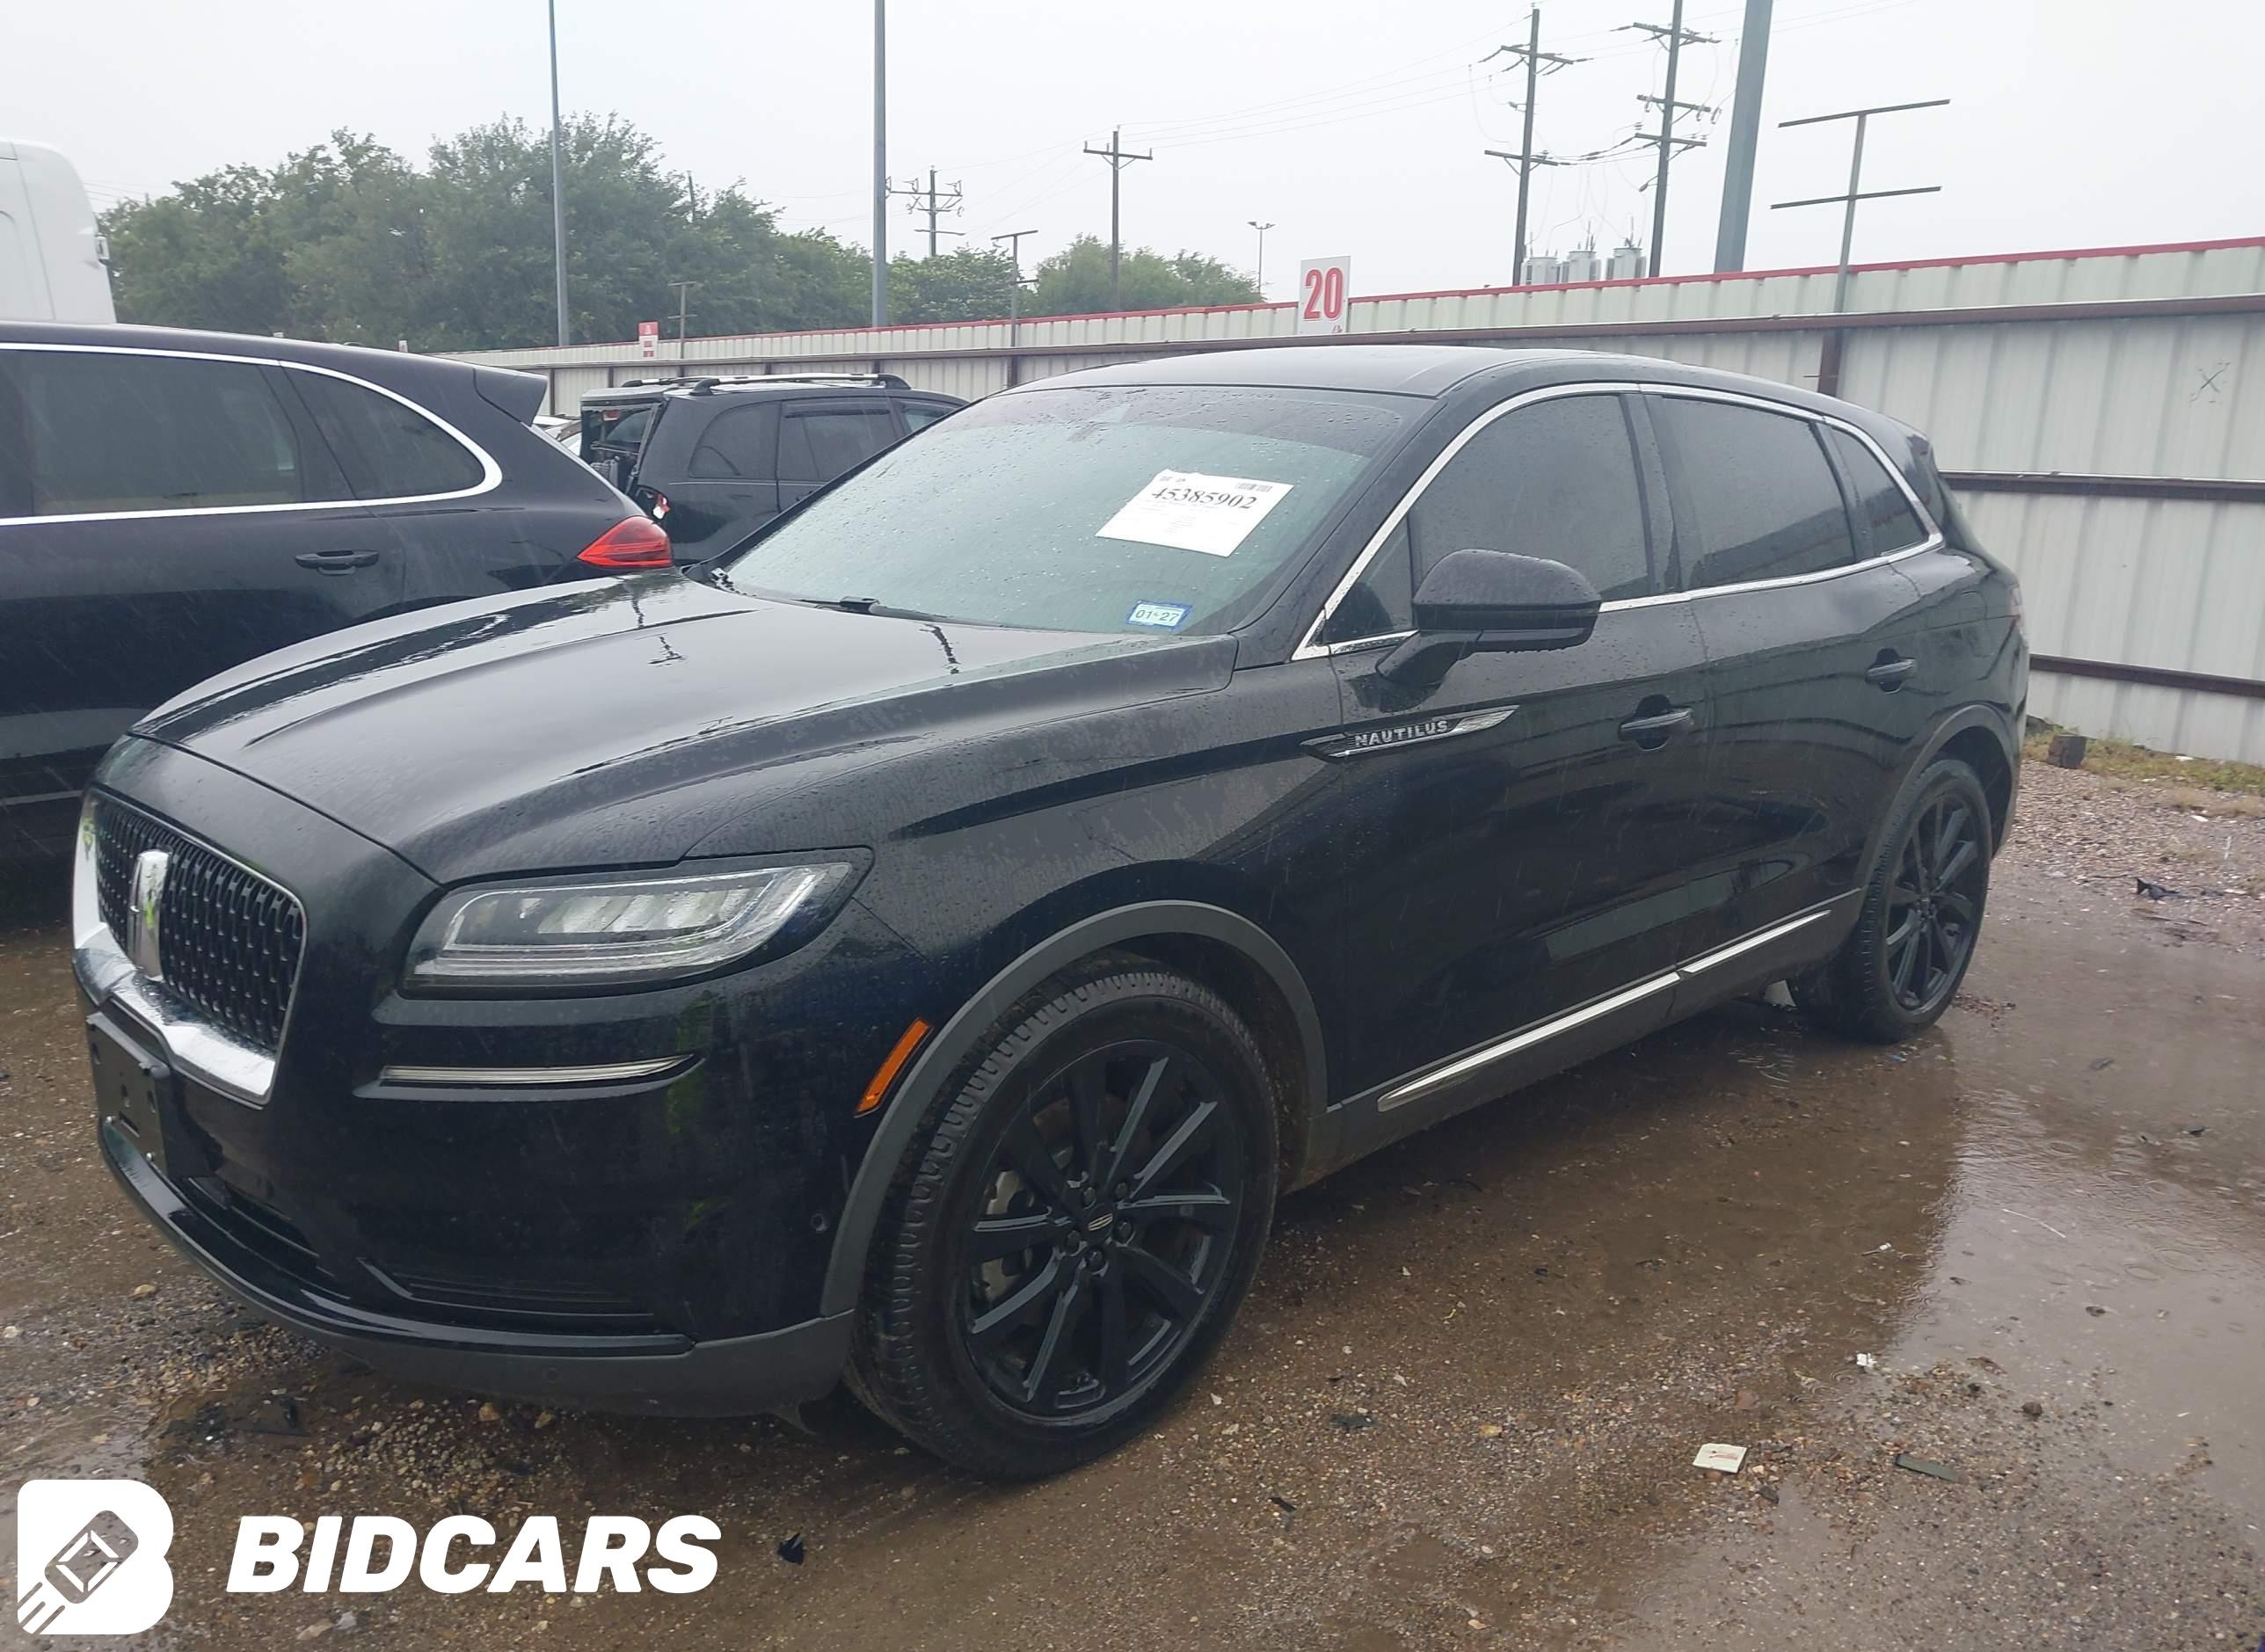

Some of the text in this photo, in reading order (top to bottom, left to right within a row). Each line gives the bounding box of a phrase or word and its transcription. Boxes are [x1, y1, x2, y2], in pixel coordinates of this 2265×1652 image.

[1303, 266, 1344, 320] 20
[1152, 487, 1257, 509] 45385902
[1354, 720, 1449, 746] NAUTILUS
